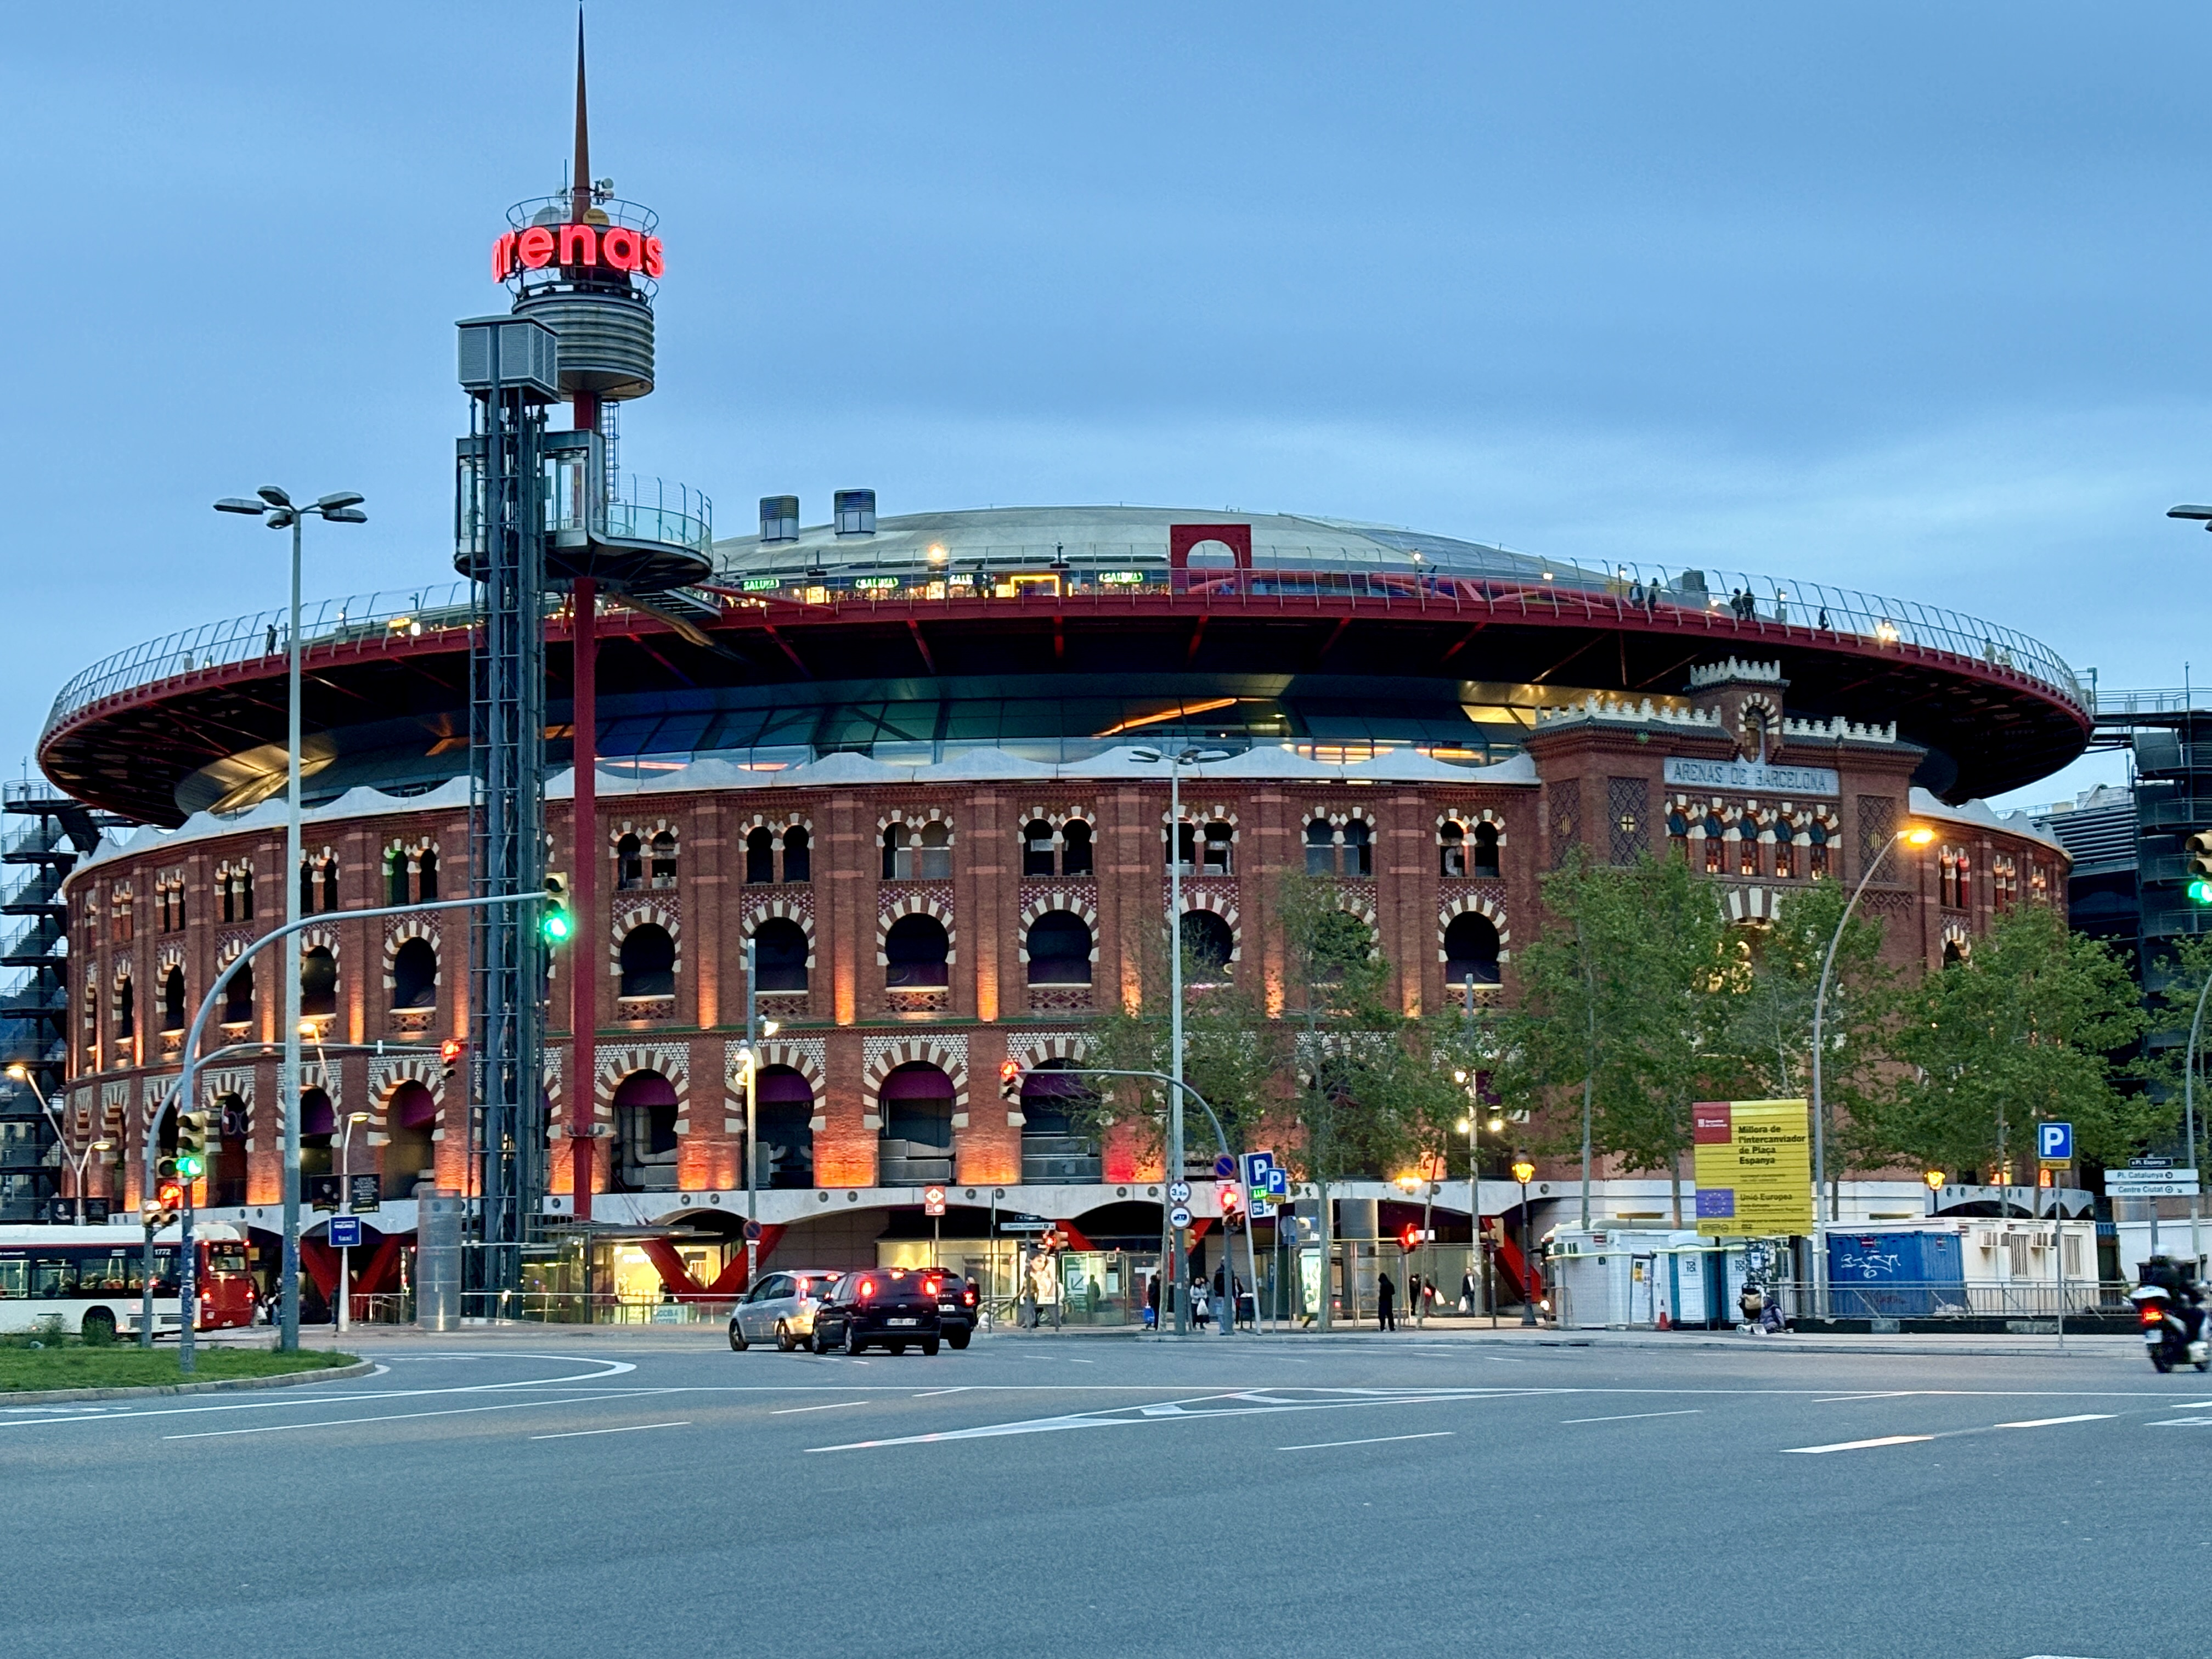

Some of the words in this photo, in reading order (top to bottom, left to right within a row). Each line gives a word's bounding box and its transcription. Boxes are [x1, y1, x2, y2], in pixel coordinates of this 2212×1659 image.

[1674, 763, 1723, 783] ARENAS
[1731, 768, 1747, 785] DE
[1756, 770, 1826, 791] BARCELONA
[1739, 1135, 1805, 1143] l'intercanviador
[2044, 1127, 2064, 1155] P
[1752, 1147, 1776, 1156] Plaça
[1740, 1157, 1775, 1166] Espanya
[1254, 1159, 1267, 1181] P
[2128, 1171, 2164, 1180] Catalunya
[1269, 1171, 1282, 1192] P
[1760, 1193, 1792, 1201] Europea
